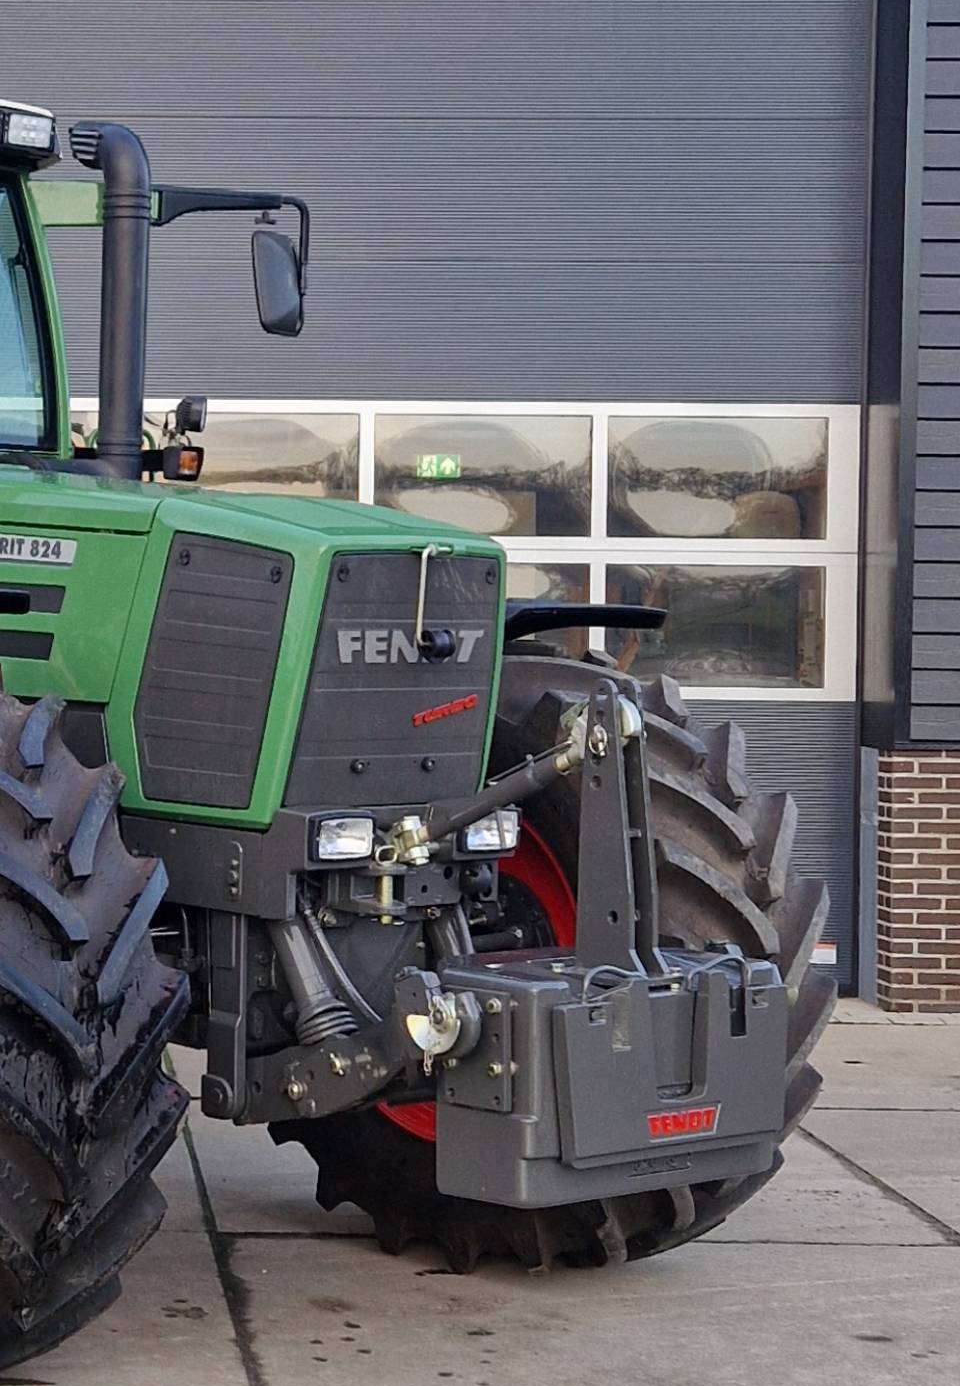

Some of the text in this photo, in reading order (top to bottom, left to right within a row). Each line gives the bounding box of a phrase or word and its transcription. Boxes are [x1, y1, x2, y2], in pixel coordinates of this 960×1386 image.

[29, 539, 62, 559] 824
[336, 628, 485, 664] FENT
[412, 694, 479, 728] TURBO
[646, 1106, 717, 1139] FENDT
